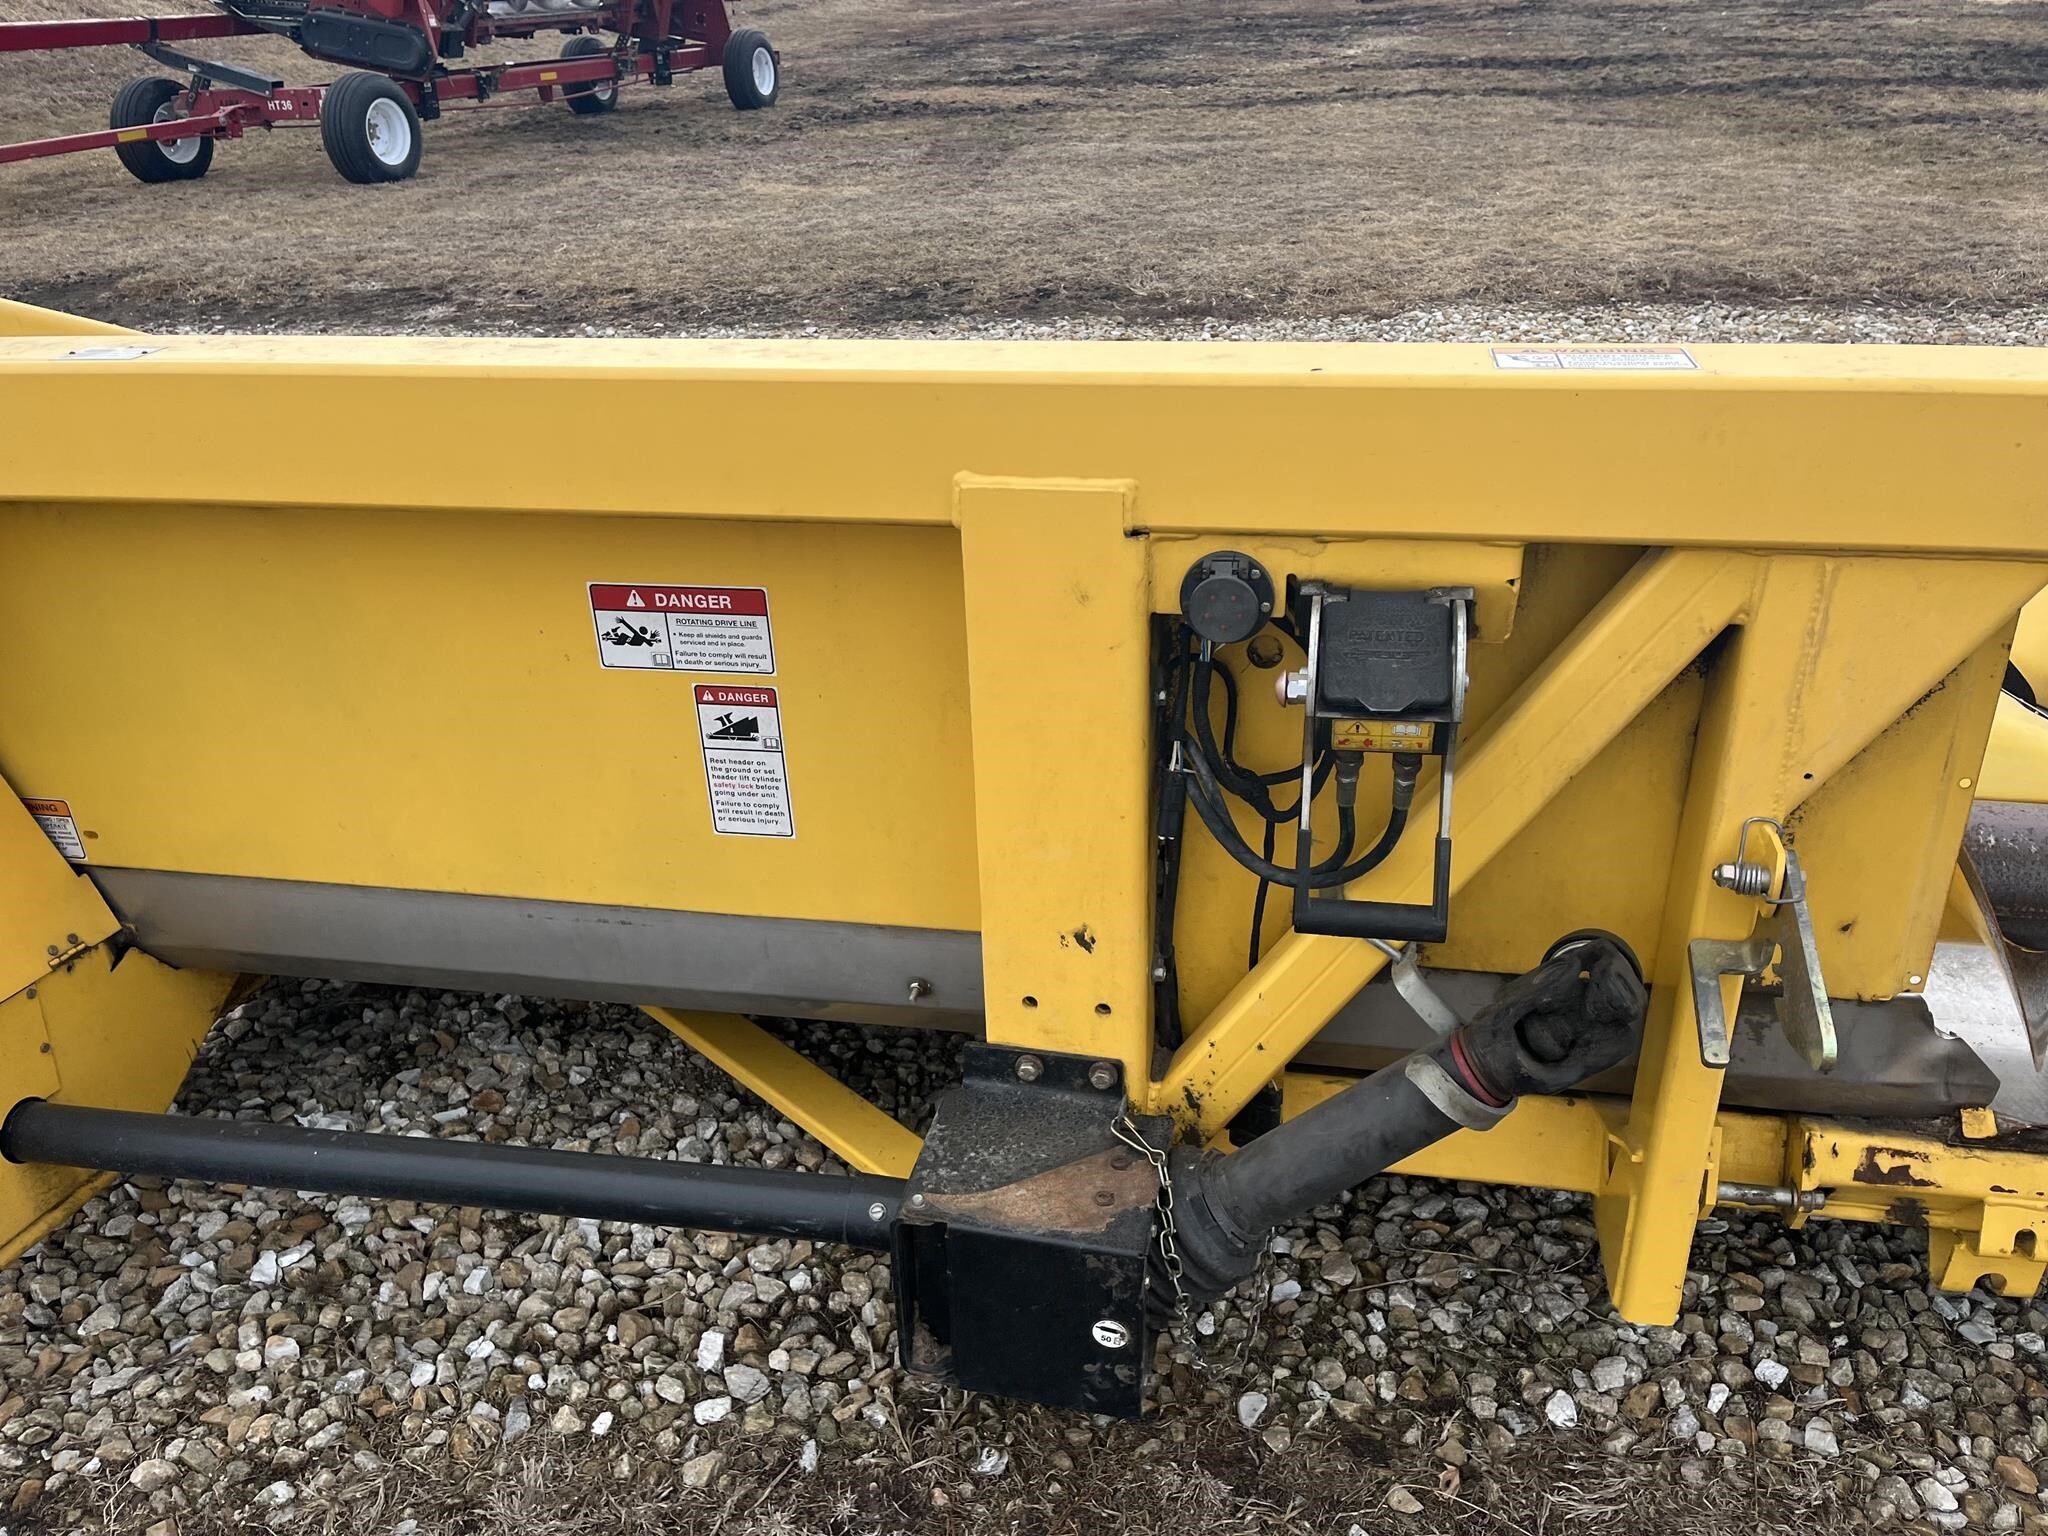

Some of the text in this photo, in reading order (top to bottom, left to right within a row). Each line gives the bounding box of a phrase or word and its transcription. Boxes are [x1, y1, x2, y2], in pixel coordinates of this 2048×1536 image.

[655, 593, 732, 609] DANGER
[675, 618, 714, 626] ROTATING
[708, 652, 733, 660] comply
[718, 692, 769, 703] DANGER
[714, 790, 735, 798] going
[753, 802, 780, 810] comply
